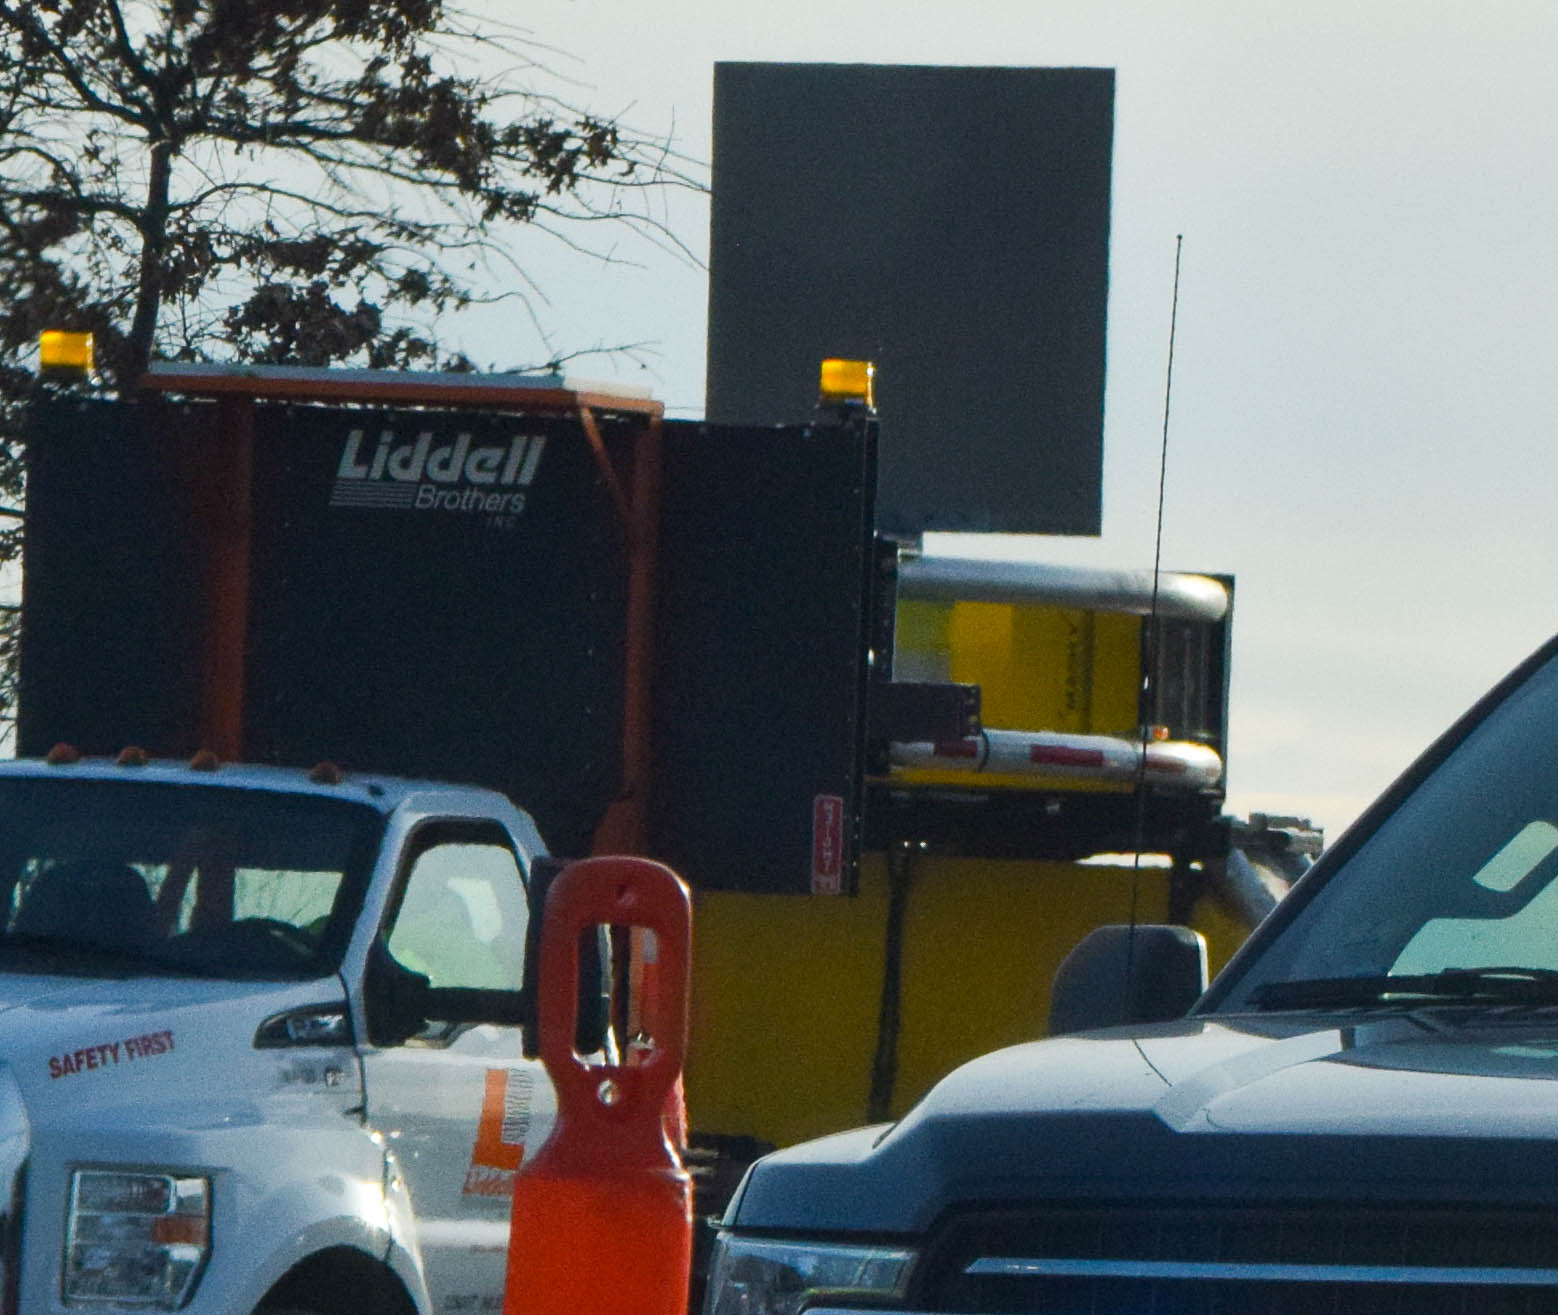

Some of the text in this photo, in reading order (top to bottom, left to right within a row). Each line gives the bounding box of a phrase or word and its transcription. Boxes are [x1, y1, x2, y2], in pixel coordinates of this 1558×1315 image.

[336, 429, 548, 486] Liddell
[415, 484, 526, 513] Brothers
[49, 1029, 175, 1080] SAFETY FIRST
